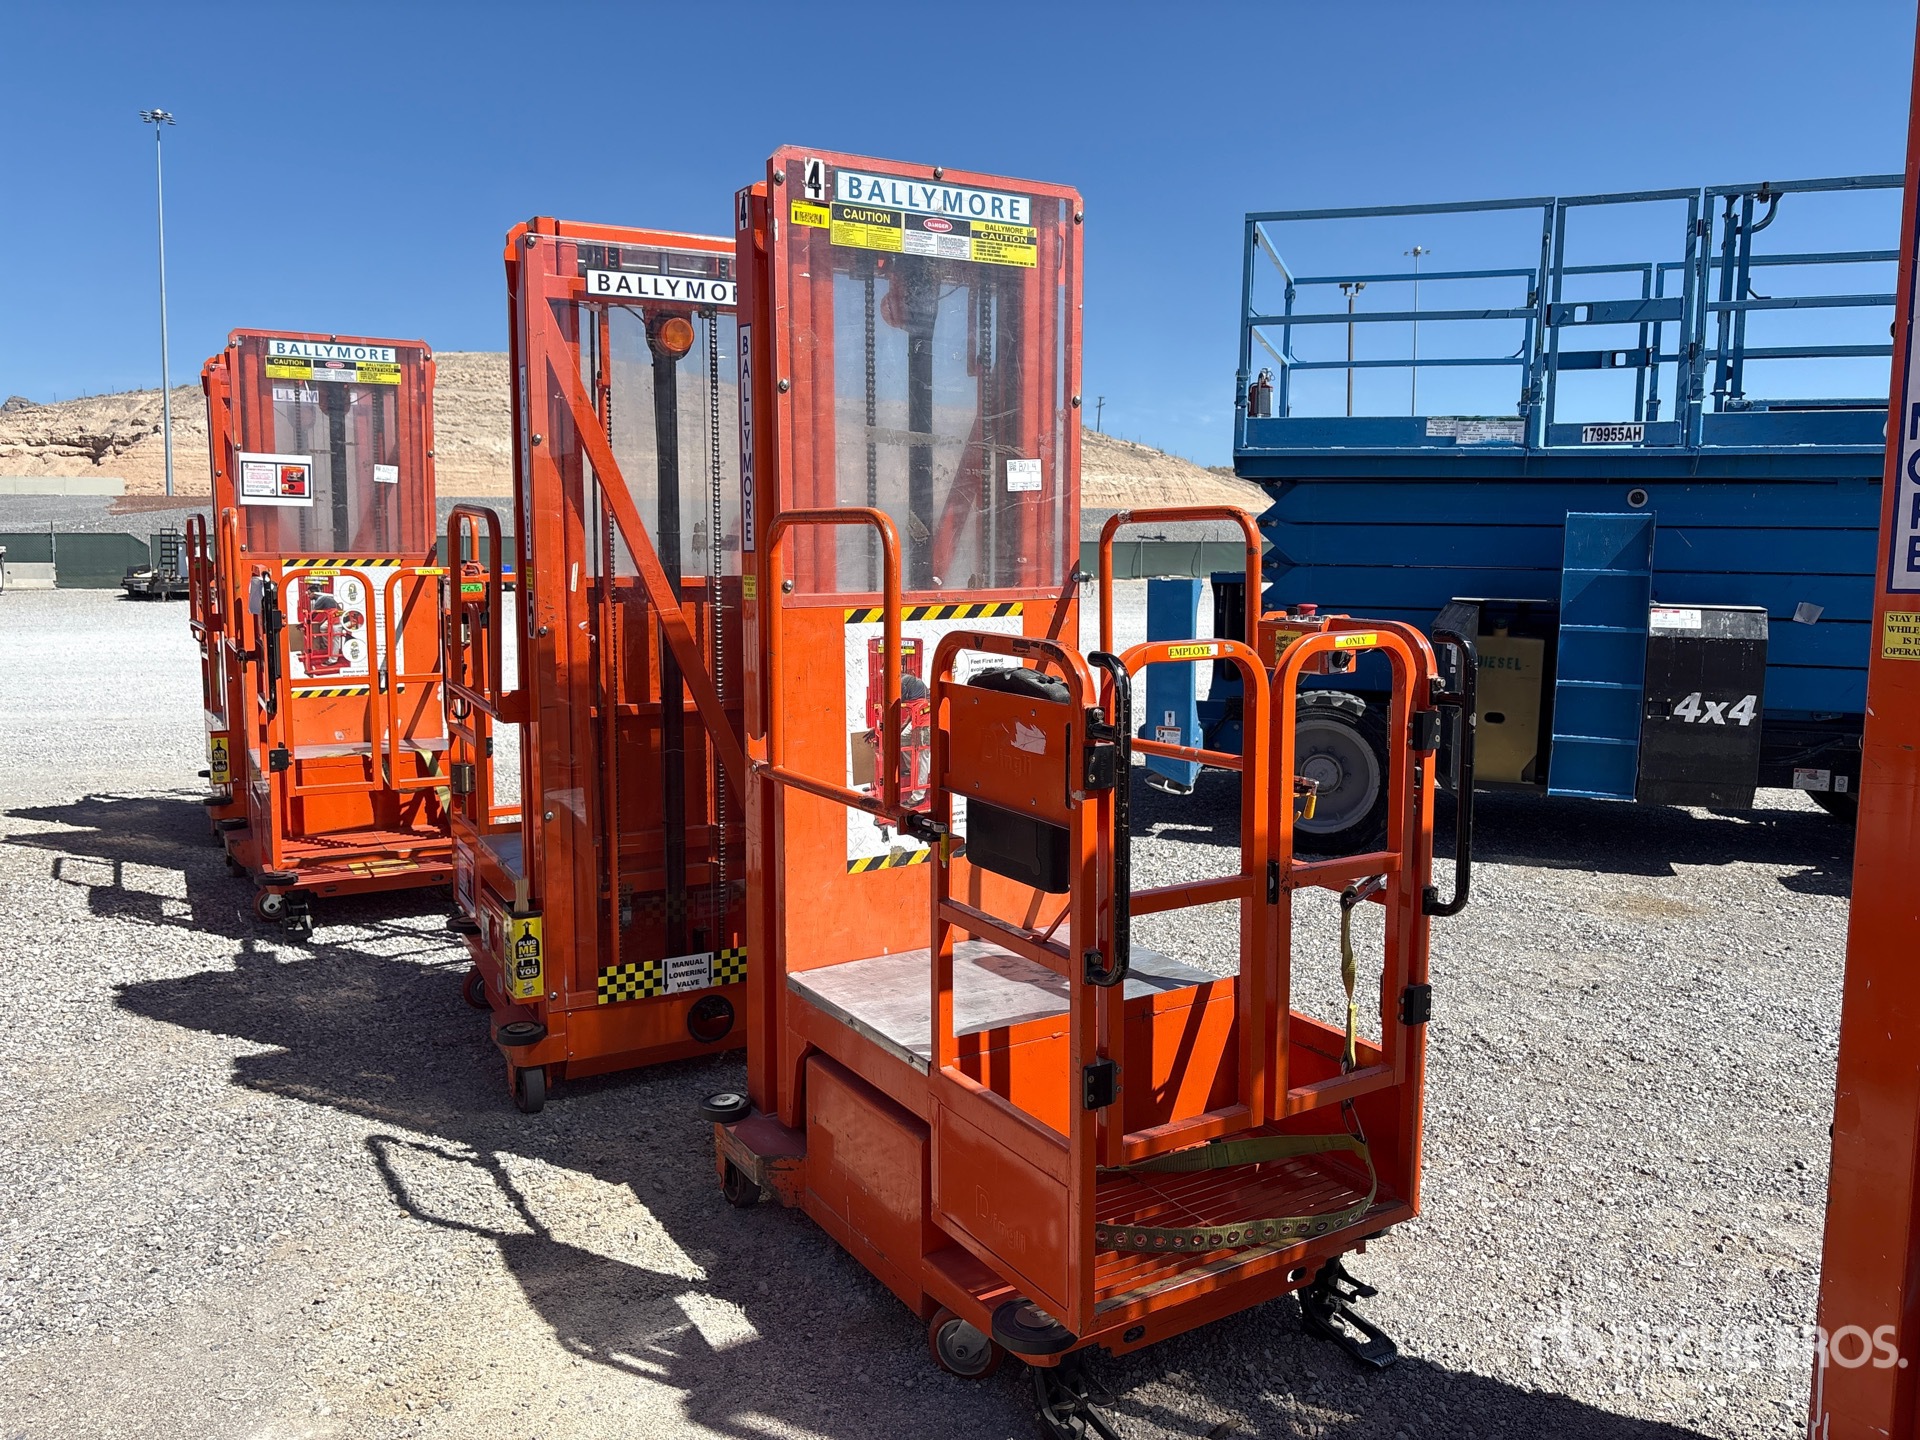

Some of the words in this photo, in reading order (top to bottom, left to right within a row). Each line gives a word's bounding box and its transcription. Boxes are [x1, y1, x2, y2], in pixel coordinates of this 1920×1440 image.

[807, 161, 822, 198] 4
[849, 176, 1020, 220] BALLYMORE
[843, 208, 891, 224] CAUTION
[985, 223, 1023, 235] BALLYMORE
[980, 232, 1028, 244] CAUTION
[276, 342, 390, 361] BALLYMORE
[273, 358, 305, 366] CAUTION
[741, 335, 752, 542] BALLYMORE
[1583, 426, 1642, 442] 179955AH
[1889, 614, 1912, 622] STAY
[1887, 625, 1920, 634] WHILE
[1345, 636, 1367, 645] ONLY
[1902, 636, 1912, 645] IS
[1673, 692, 1758, 726] 4x4
[518, 939, 537, 947] PLUG
[518, 944, 537, 955] ME
[671, 958, 704, 969] MANUAL
[519, 967, 538, 976] YOU
[668, 967, 707, 979] LOWERING
[676, 979, 700, 988] VALVE
